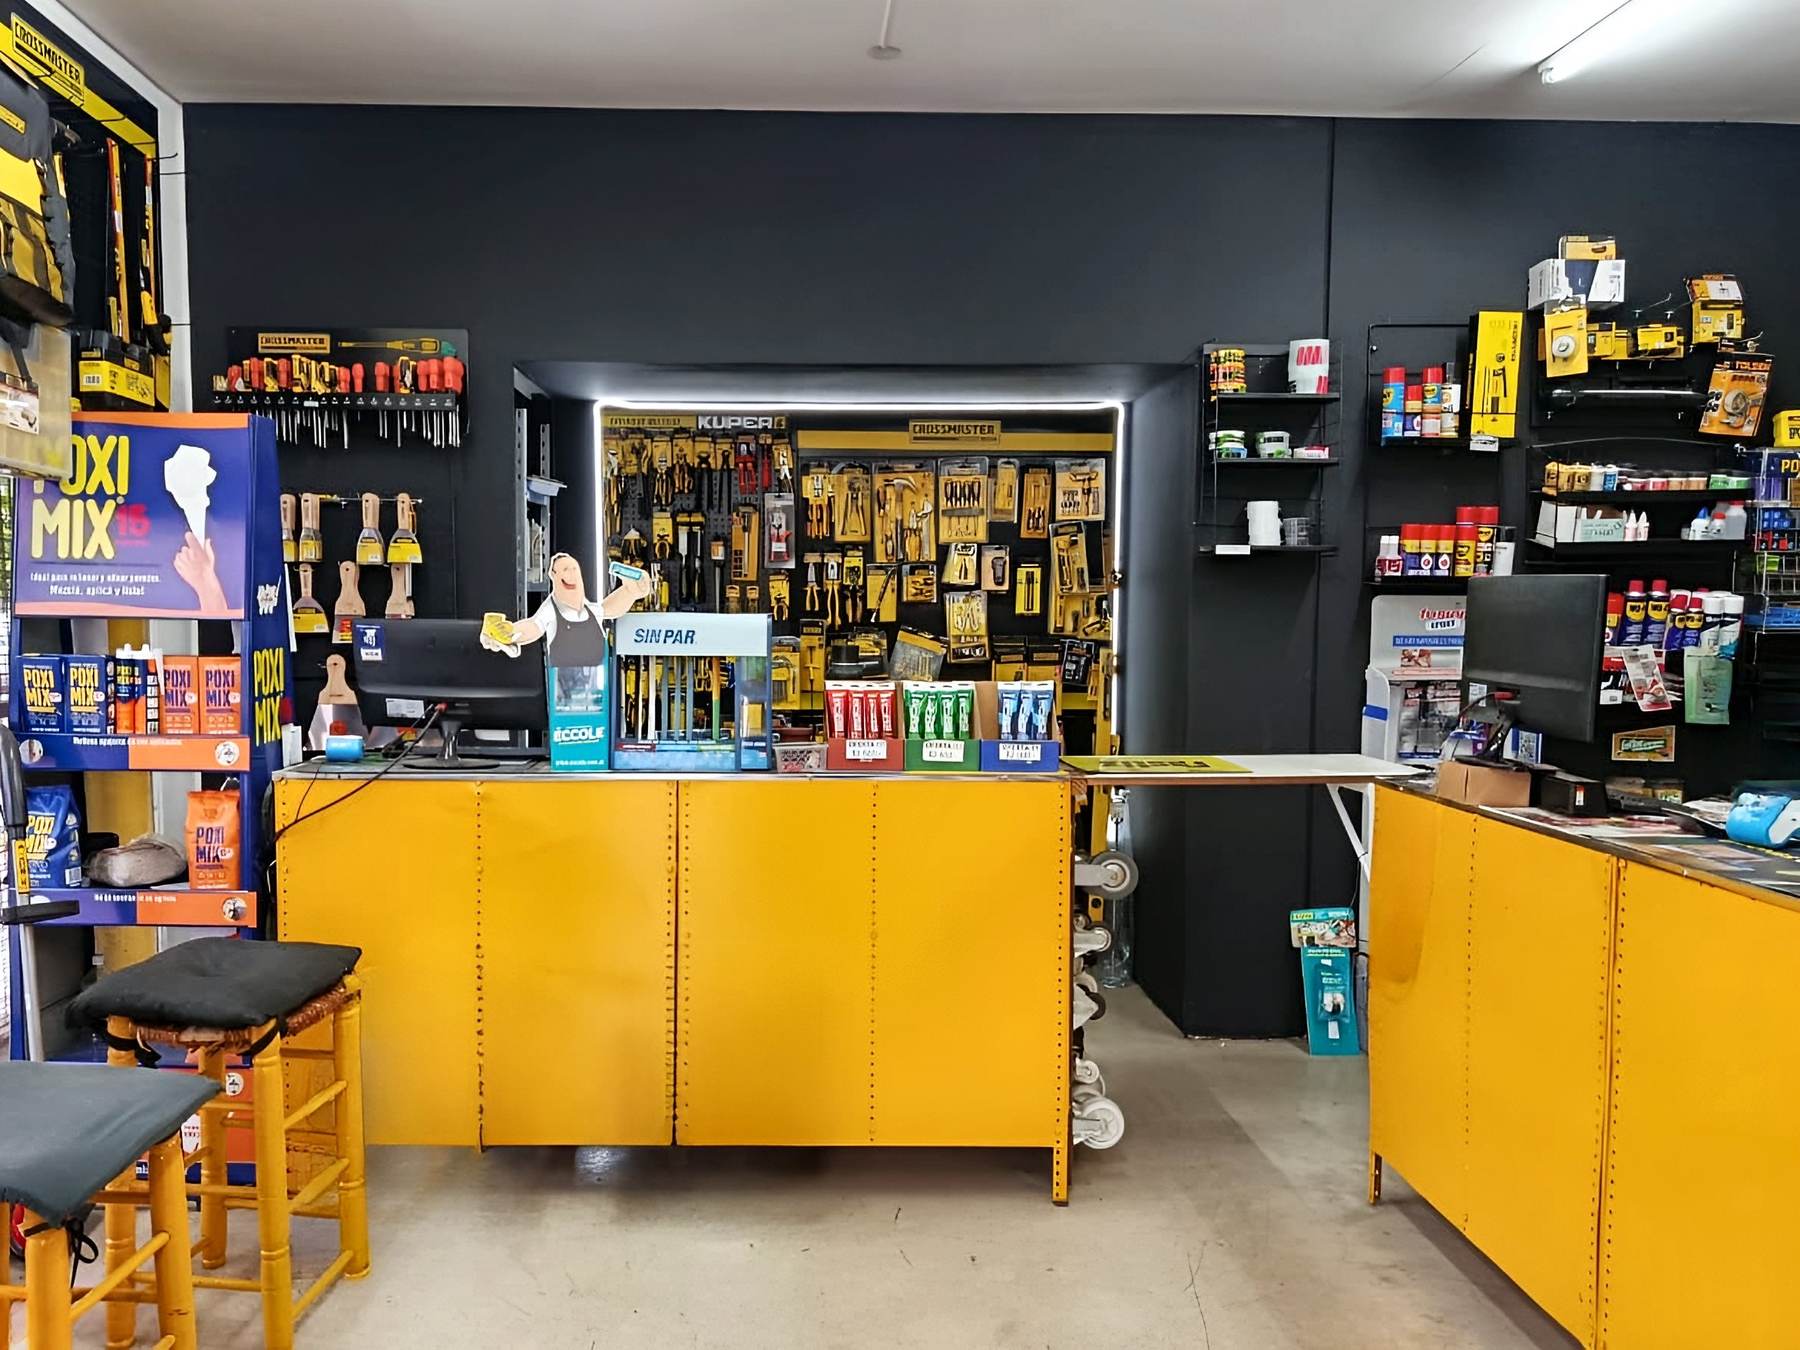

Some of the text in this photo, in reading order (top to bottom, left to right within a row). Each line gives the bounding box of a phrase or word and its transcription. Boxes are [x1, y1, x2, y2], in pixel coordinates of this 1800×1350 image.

[15, 21, 81, 84] CROSSMASTER
[912, 423, 995, 434] CROSSMASTER
[33, 434, 130, 496] OXI
[31, 498, 117, 560] MIX
[23, 668, 55, 688] POXI
[70, 667, 99, 687] POXI
[164, 669, 191, 688] POXI
[205, 669, 235, 688] POXI
[253, 647, 284, 697] POXI
[25, 687, 52, 707] MIX
[70, 687, 95, 706] MIX
[164, 689, 188, 707] MIX
[206, 689, 231, 707] MIX
[255, 695, 282, 747] MIX
[26, 815, 56, 834] POXI
[196, 826, 224, 844] POXI
